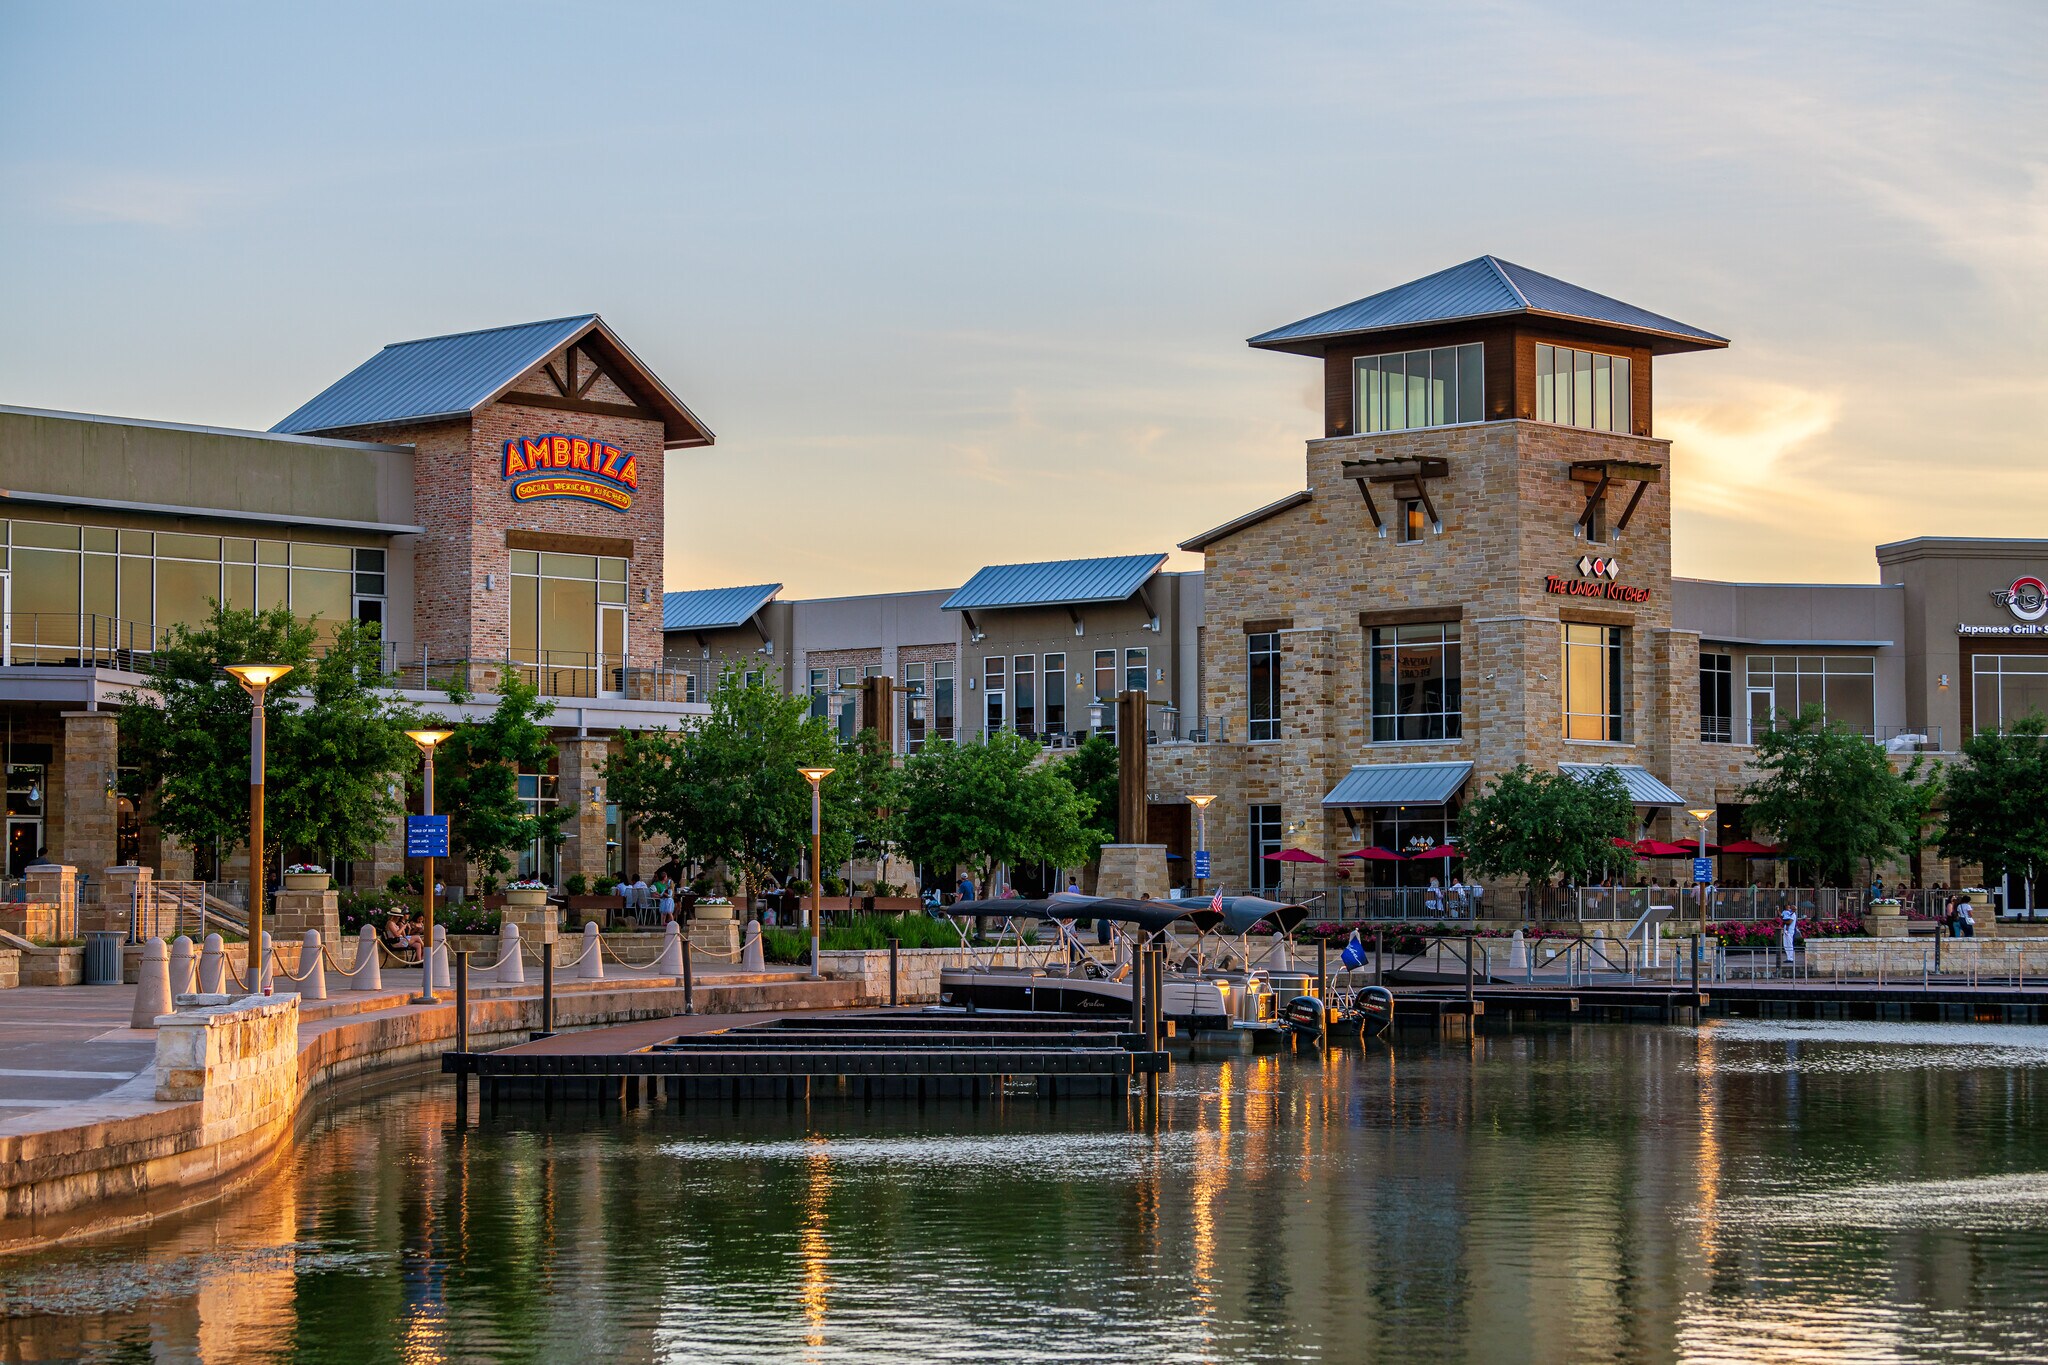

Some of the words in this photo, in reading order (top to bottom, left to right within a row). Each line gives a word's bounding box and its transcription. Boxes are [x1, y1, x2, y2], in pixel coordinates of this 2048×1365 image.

[505, 435, 638, 489] AMBRIZA
[520, 484, 551, 494] SOCIAL
[554, 483, 591, 493] MEXICAN
[594, 487, 628, 503] KITCHEN
[1545, 575, 1568, 594] THE
[1568, 579, 1604, 597] UNION
[1606, 582, 1651, 602] KITCHEN
[1958, 624, 2010, 634] Japanese
[2012, 624, 2036, 634] Grill
[1077, 998, 1105, 1008] Avalon
